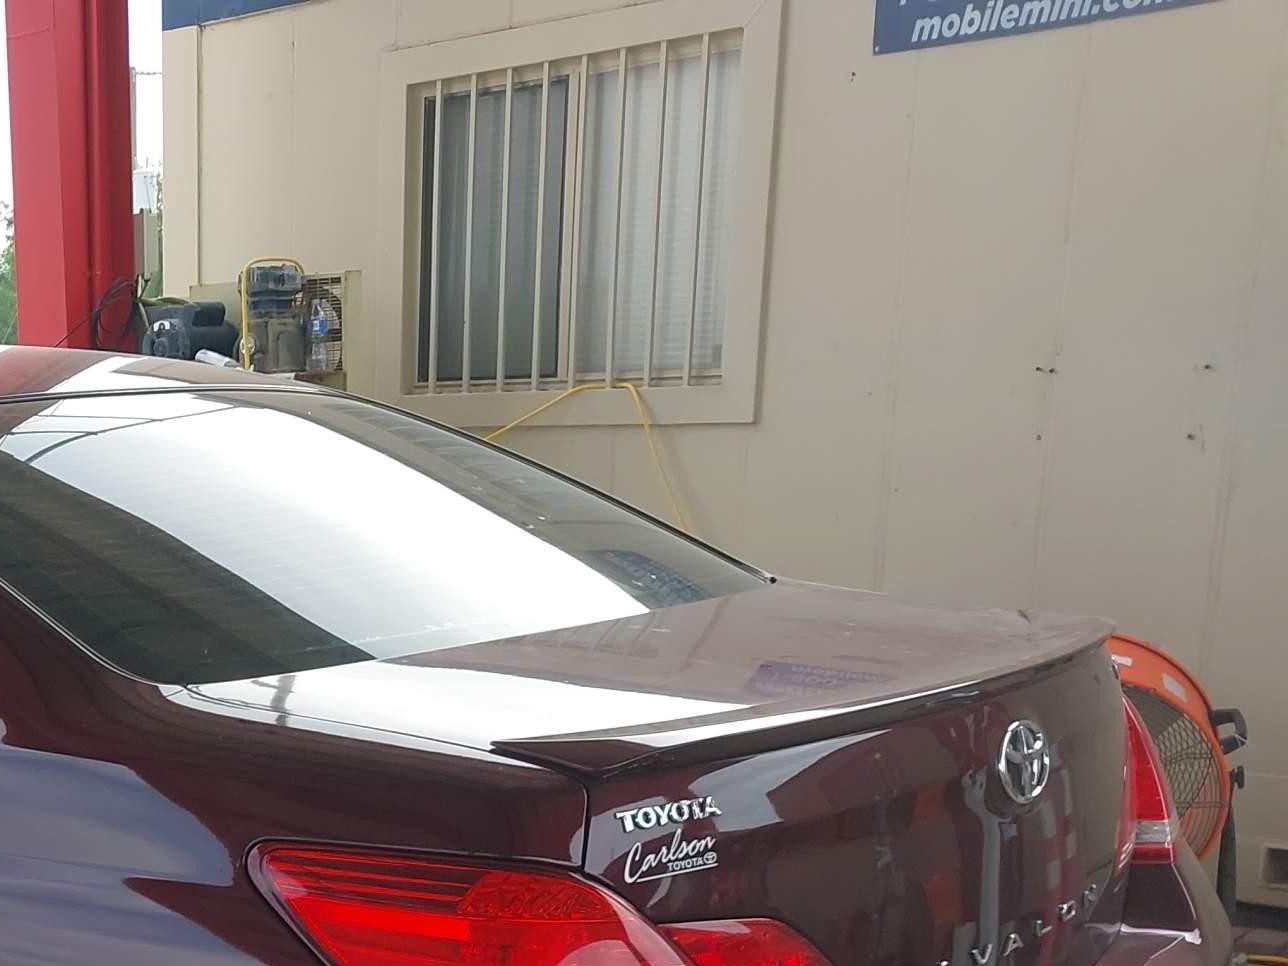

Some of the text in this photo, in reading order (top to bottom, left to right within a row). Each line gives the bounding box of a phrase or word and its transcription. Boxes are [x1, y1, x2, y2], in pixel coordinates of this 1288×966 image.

[911, 0, 1175, 43] mobilemini.c
[615, 796, 722, 833] TOYOTA
[623, 828, 717, 884] Carlson
[667, 857, 704, 872] TOYOTA
